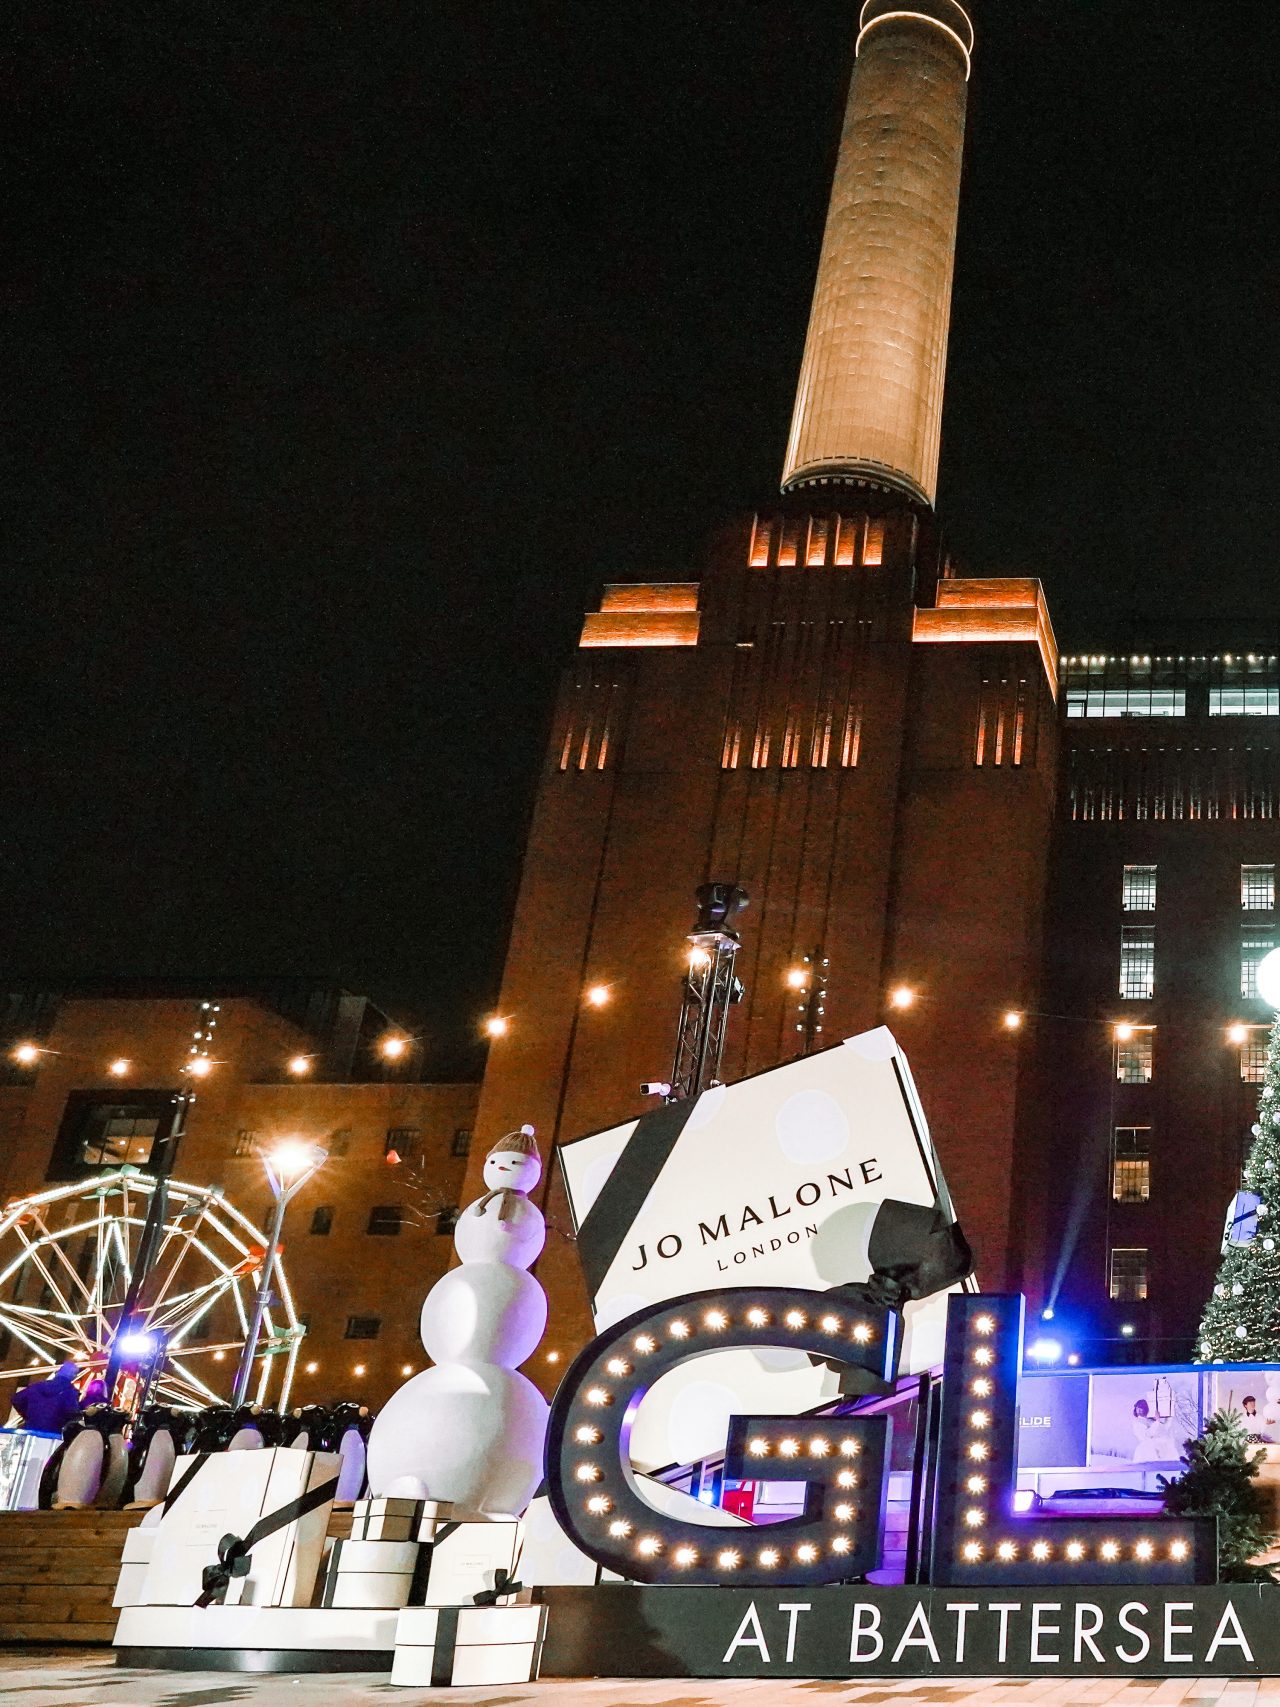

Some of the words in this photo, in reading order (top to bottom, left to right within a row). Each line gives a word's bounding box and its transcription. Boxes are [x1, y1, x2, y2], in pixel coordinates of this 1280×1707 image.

[633, 1235, 683, 1271] JO
[699, 1158, 883, 1246] MALONE
[717, 1223, 818, 1272] LONDON
[1018, 1416, 1051, 1426] LIDE
[722, 1601, 812, 1663] AT
[849, 1600, 1255, 1663] BATTERSEA
